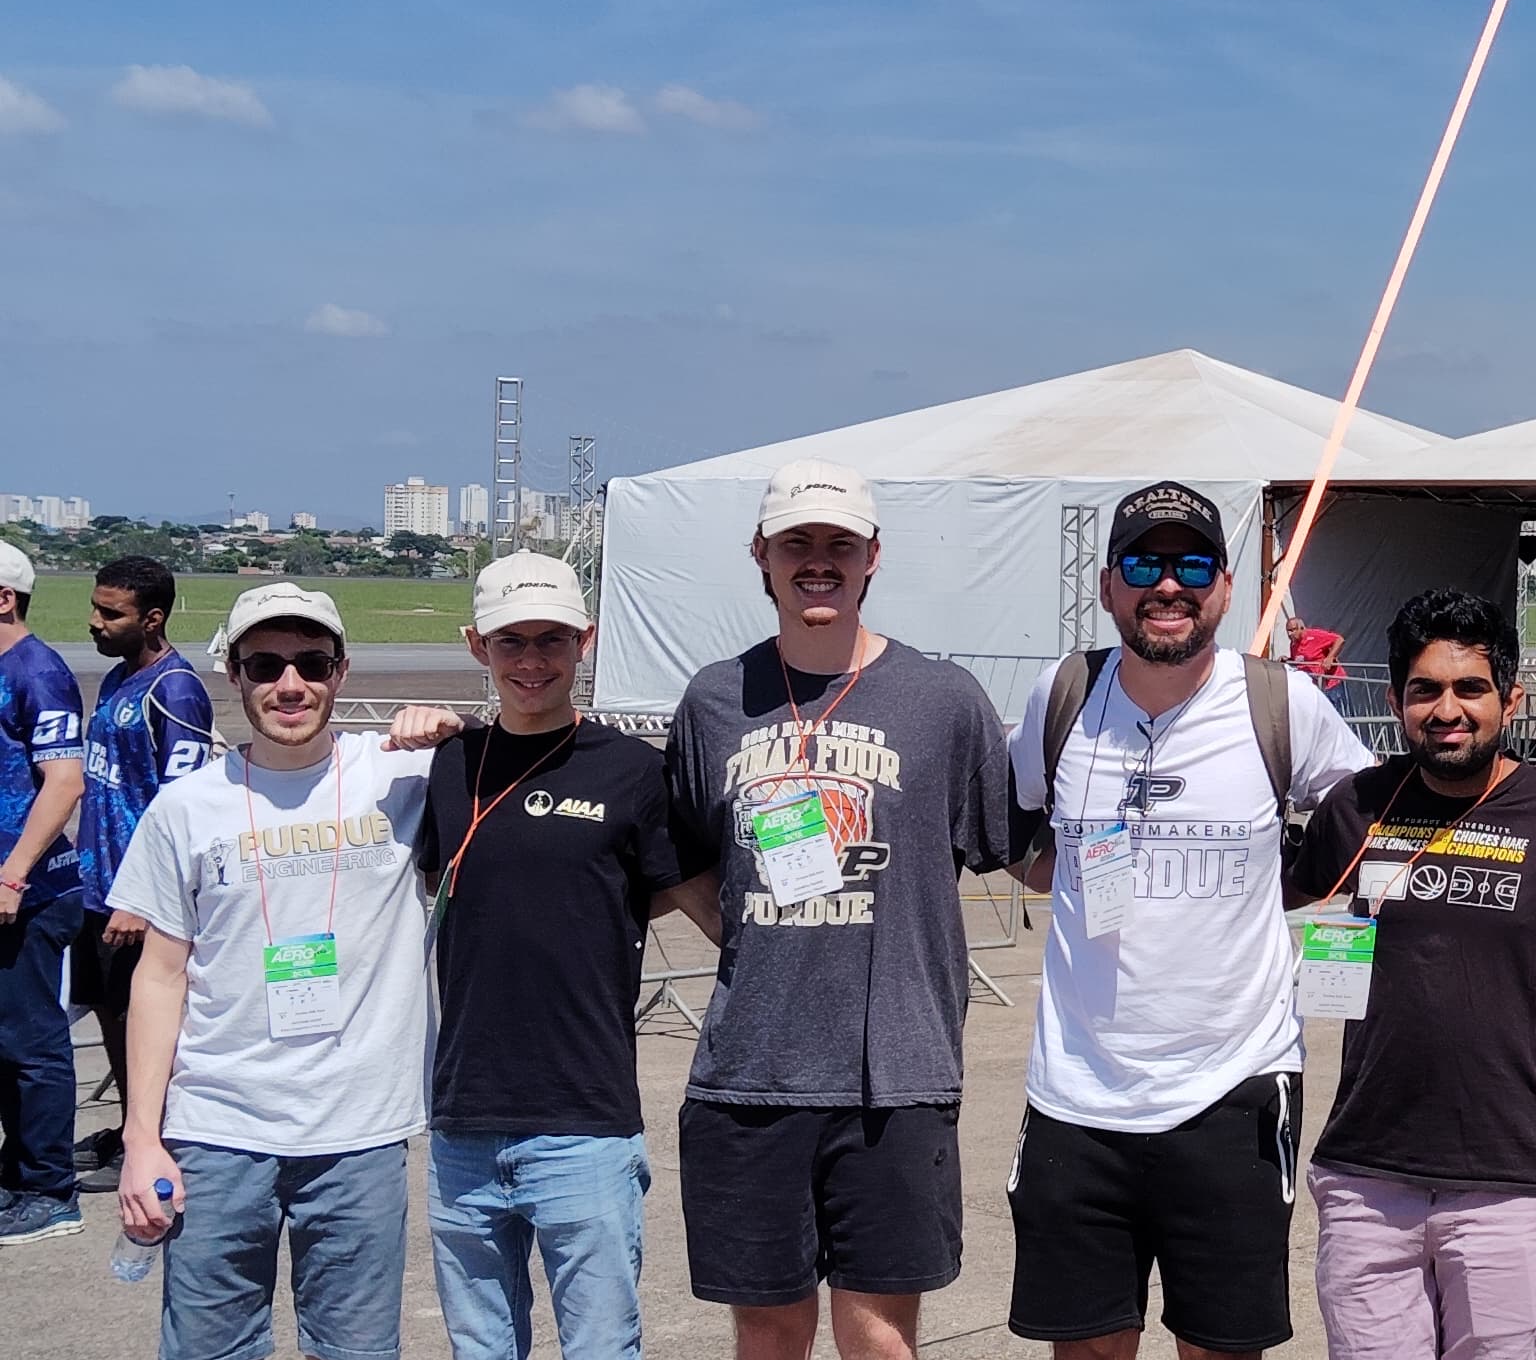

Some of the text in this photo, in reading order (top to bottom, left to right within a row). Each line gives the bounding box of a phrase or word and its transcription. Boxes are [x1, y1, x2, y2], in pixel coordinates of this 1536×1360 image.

[1122, 488, 1213, 523] REALTREE
[723, 735, 903, 796] FINAL FOUR
[554, 798, 606, 819] AIAA
[238, 813, 390, 862] PURDUE
[1062, 822, 1247, 837] BOIRMAKERS
[1452, 829, 1530, 851] CHOICES MAKE
[241, 847, 398, 883] ENGINEERING
[1446, 842, 1526, 864] CHAMPIONS
